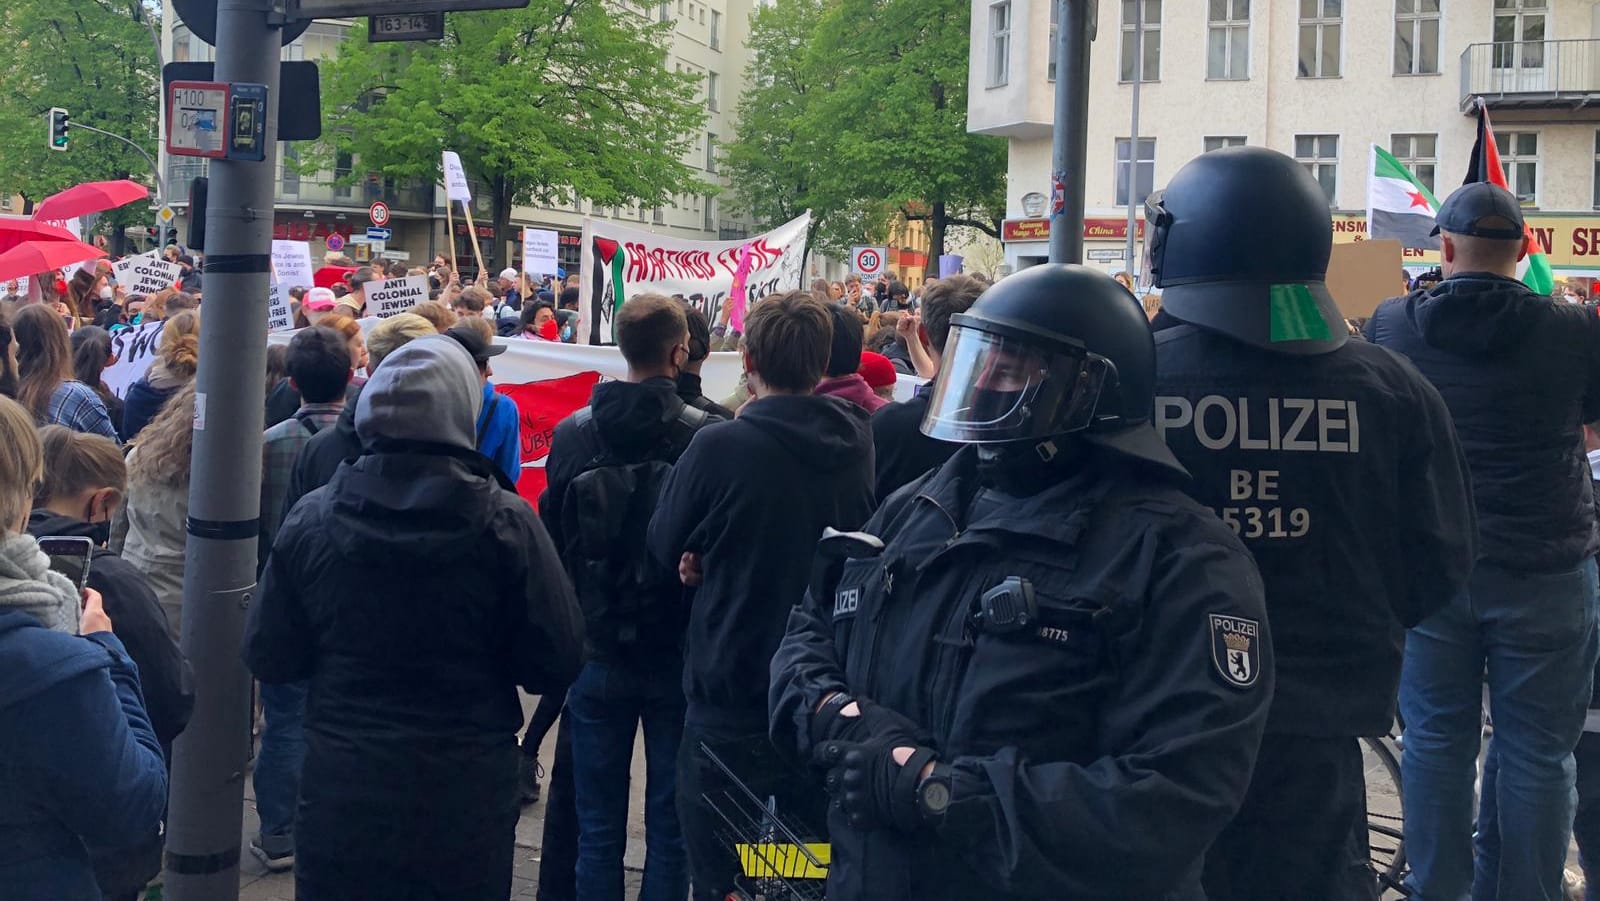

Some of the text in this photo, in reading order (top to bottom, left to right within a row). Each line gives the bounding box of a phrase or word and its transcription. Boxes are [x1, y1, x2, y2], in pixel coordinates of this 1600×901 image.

[174, 90, 205, 106] H100
[374, 208, 386, 220] 30
[1572, 227, 1600, 256] SP
[1402, 247, 1425, 257] EN
[149, 261, 170, 271] ANTI
[624, 241, 717, 283] APARTHEID
[862, 255, 876, 267] 30
[134, 266, 175, 282] COLONIAL
[140, 276, 169, 289] JEWISH
[384, 279, 407, 289] ANTI
[270, 287, 278, 296] SH
[371, 287, 423, 301] COLONIAL
[269, 297, 280, 307] ERS
[381, 298, 416, 311] JEWISH
[272, 307, 286, 318] FREE
[269, 318, 288, 329] STINE
[1154, 394, 1360, 453] POLIZEI
[1230, 469, 1280, 501] BE
[1222, 507, 1311, 539] 5319
[833, 588, 859, 617] LIZEI
[1040, 626, 1069, 642] 8775
[1214, 618, 1256, 637] POLIZEI
